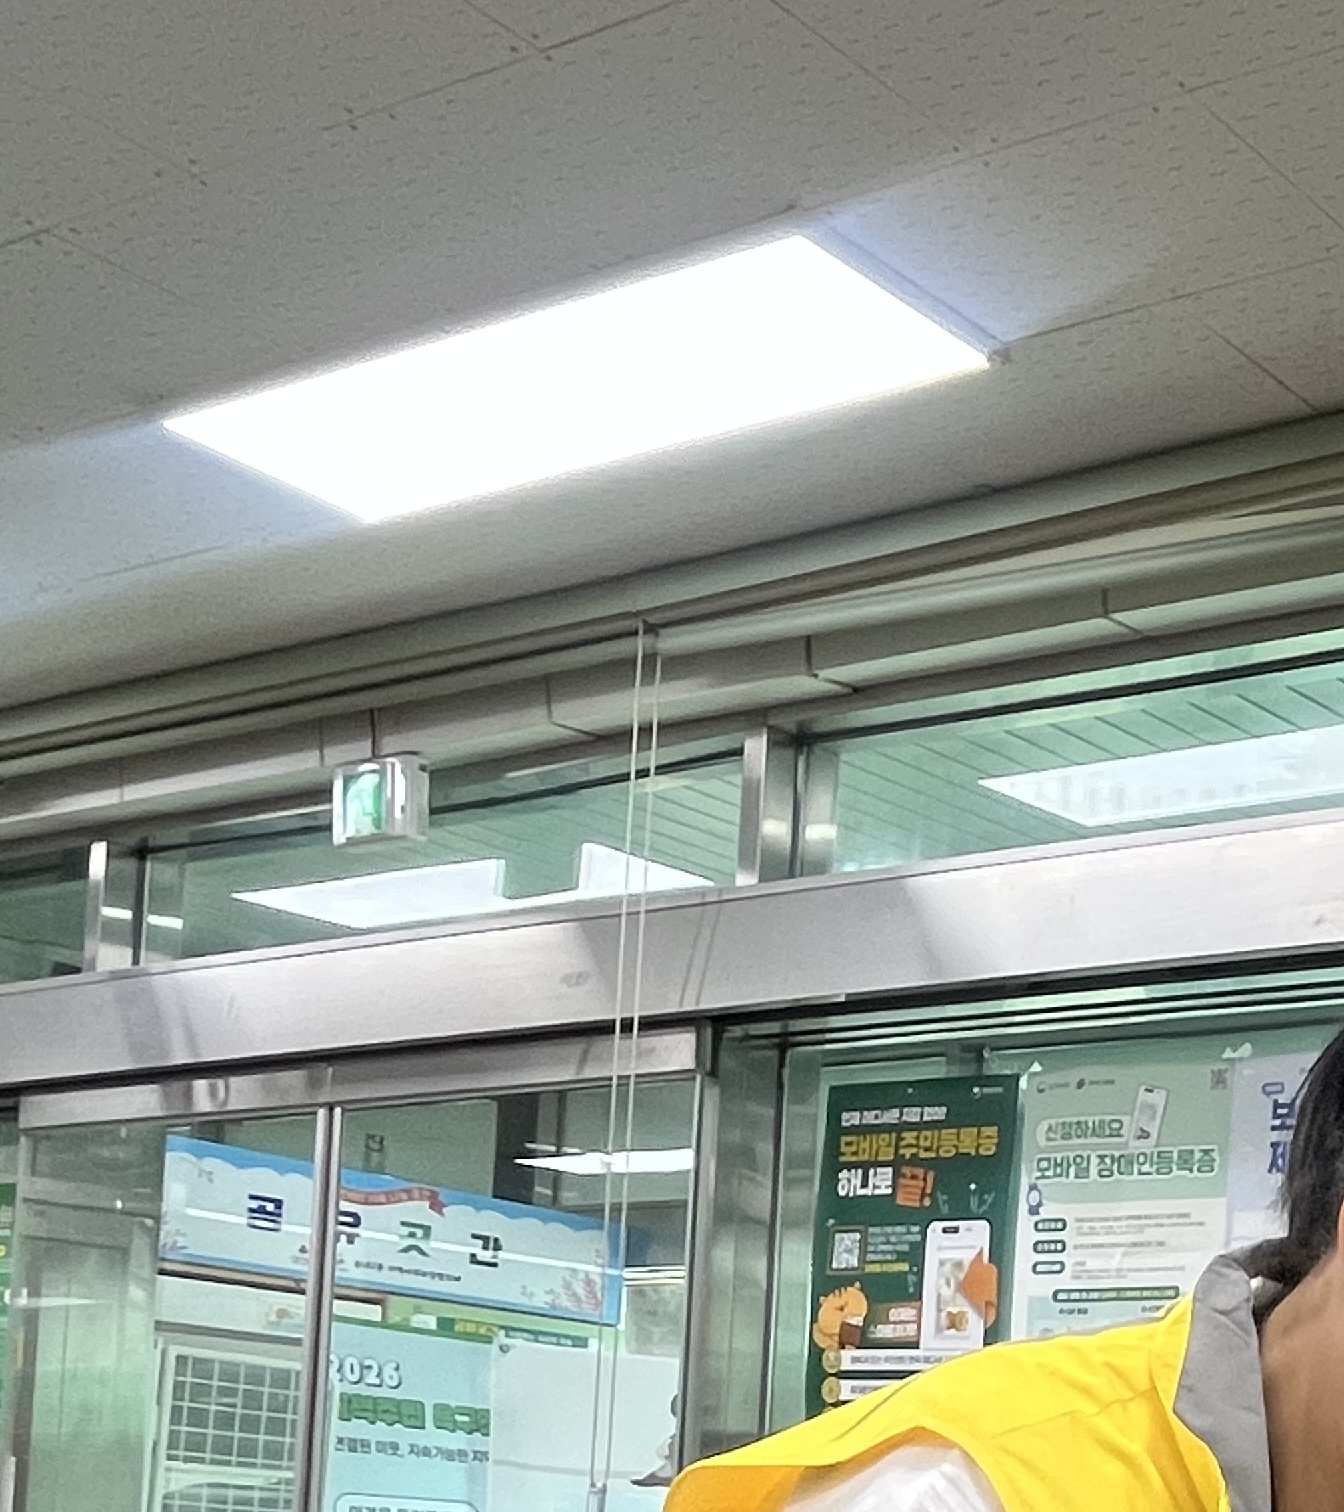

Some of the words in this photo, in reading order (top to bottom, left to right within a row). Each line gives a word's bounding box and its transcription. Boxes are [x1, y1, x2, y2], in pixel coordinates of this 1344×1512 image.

[839, 1132, 897, 1162] 모바일
[899, 1126, 999, 1160] 주민등록증
[1045, 1118, 1124, 1141] 신청하세요
[1035, 1153, 1092, 1179] 모바일
[1097, 1148, 1217, 1178] 장애인등록증
[837, 1166, 893, 1197] 하나로
